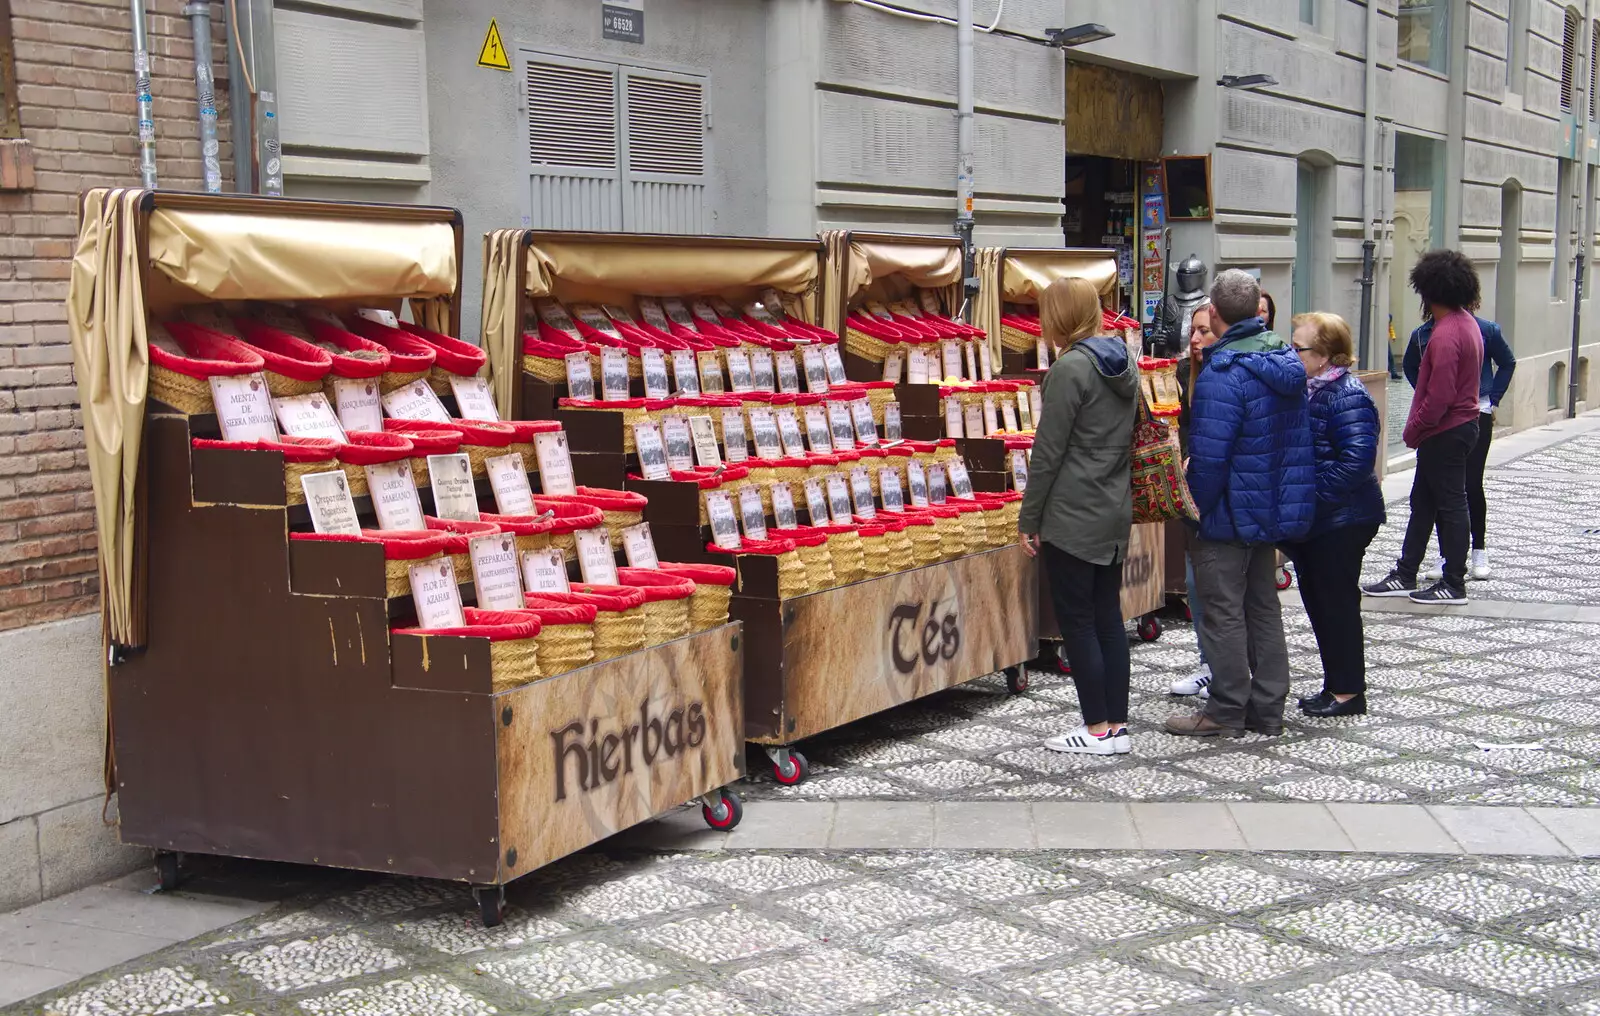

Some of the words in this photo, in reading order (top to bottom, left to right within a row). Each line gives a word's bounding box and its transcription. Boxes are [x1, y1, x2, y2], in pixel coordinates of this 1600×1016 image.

[230, 393, 258, 404] MENTA
[241, 405, 252, 414] DE
[297, 411, 318, 420] COLA
[225, 418, 248, 428] SIERRA
[248, 415, 275, 425] NEVADA
[290, 424, 302, 432] DE
[303, 419, 337, 431] CABALLO
[383, 479, 404, 490] CARDO
[382, 491, 411, 503] MARIANO
[478, 553, 513, 566] PREPARADO
[535, 568, 556, 577] HIERBA
[423, 581, 438, 592] FLOR
[439, 579, 448, 588] DE
[427, 592, 450, 605] AZAHAR
[888, 601, 960, 675] Tés
[550, 696, 706, 803] Hierbas
